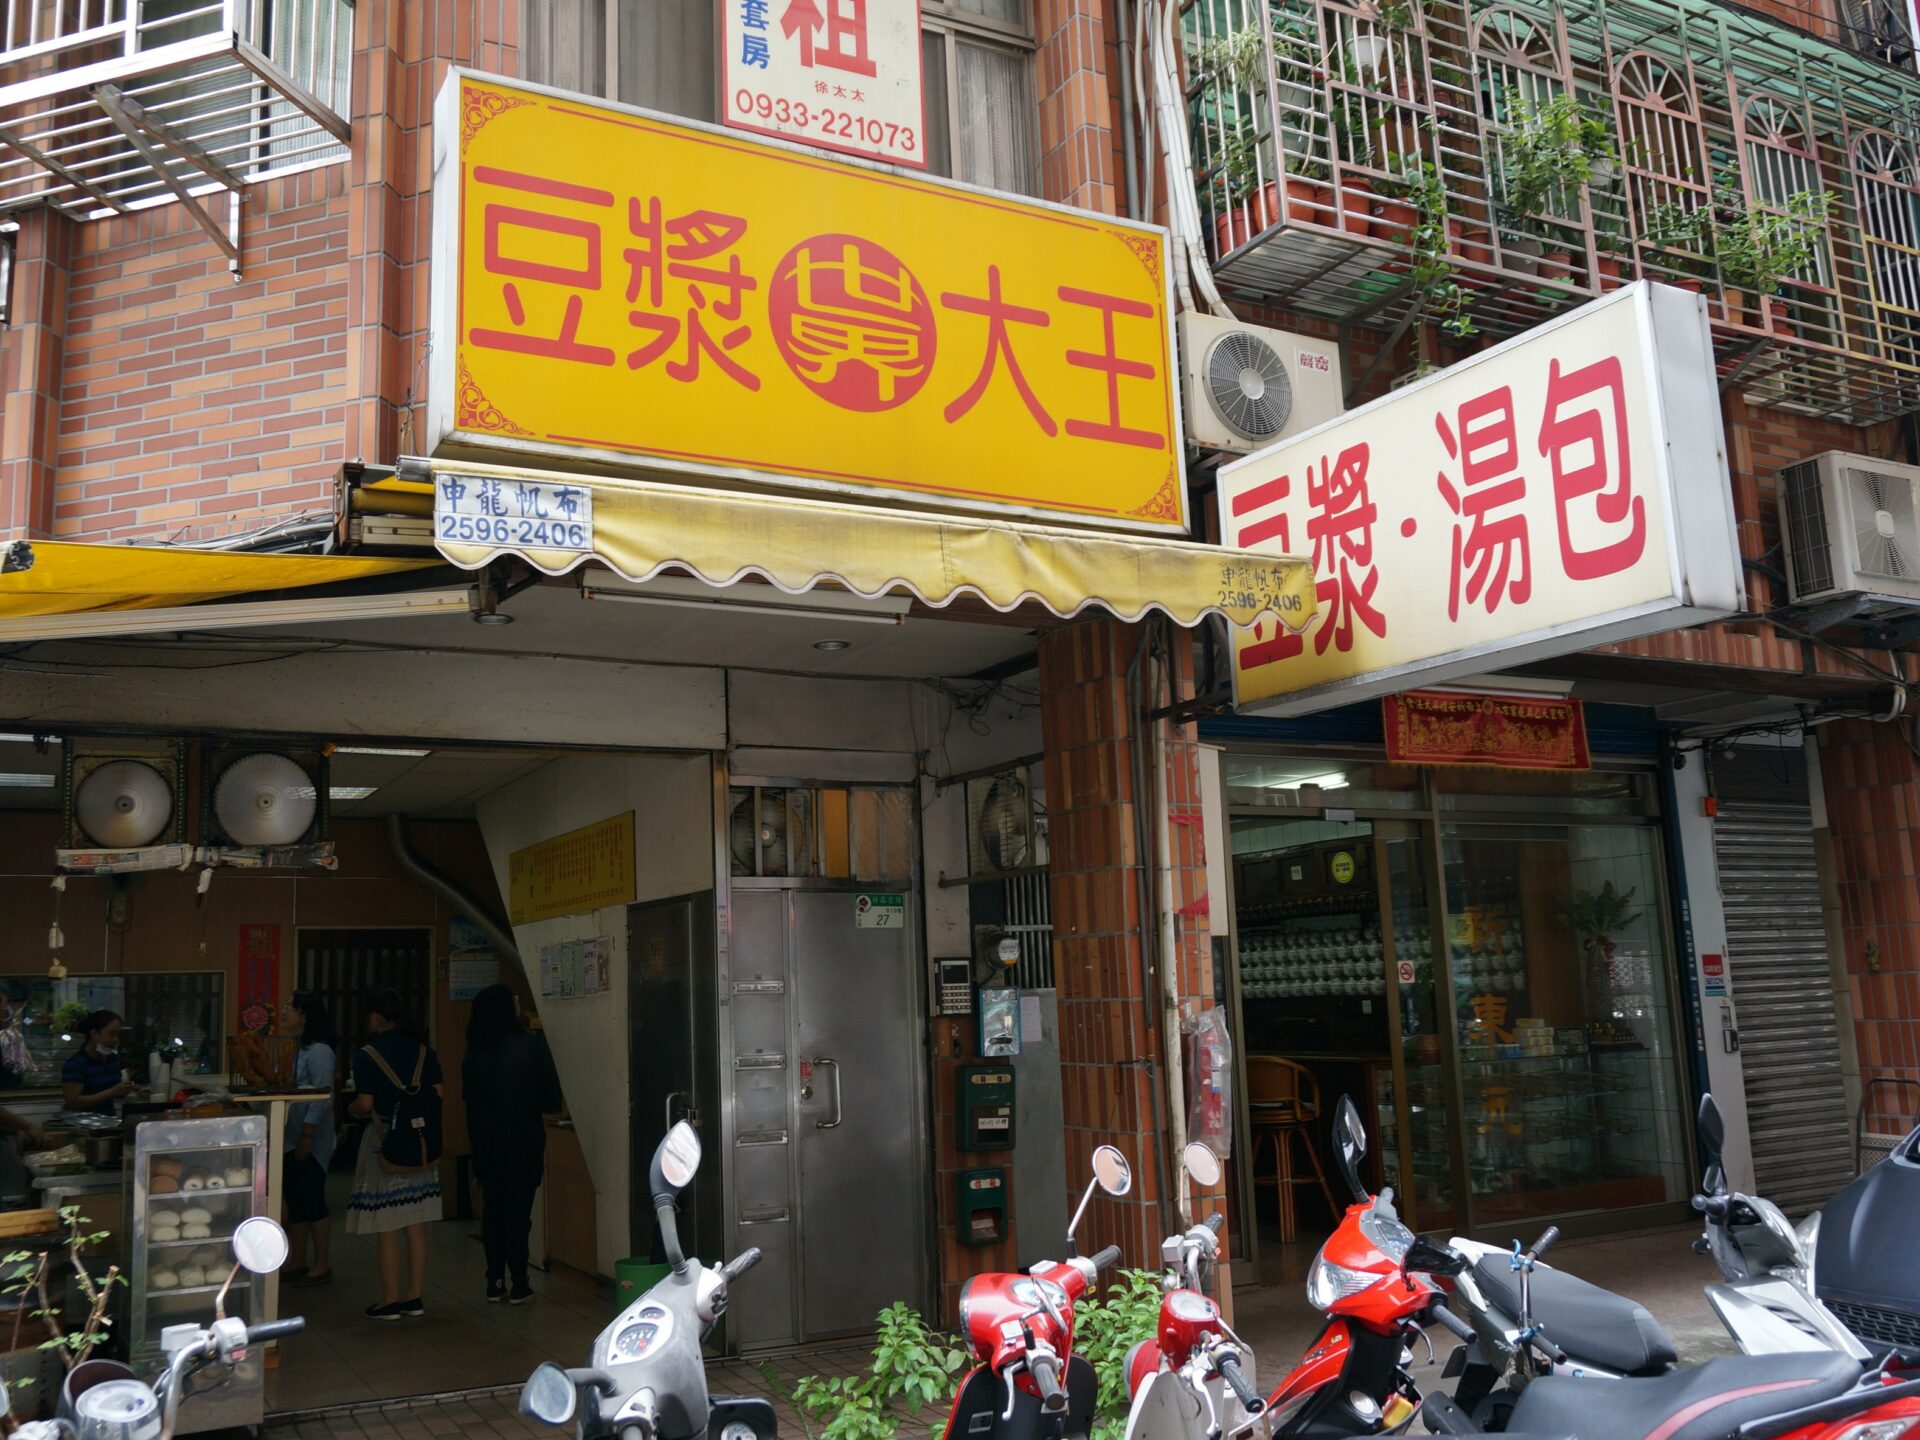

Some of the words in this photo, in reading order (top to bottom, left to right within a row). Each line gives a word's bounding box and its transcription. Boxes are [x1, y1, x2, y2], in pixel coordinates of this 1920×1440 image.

[740, 0, 770, 69] 套房
[780, 0, 877, 78] 租
[814, 80, 865, 103] 徐太太
[735, 88, 916, 152] 0933-221073
[441, 476, 582, 522] 申龍帆布
[440, 515, 584, 547] 2596-2406
[1217, 590, 1303, 612] 2596-2406
[876, 914, 890, 926] 27
